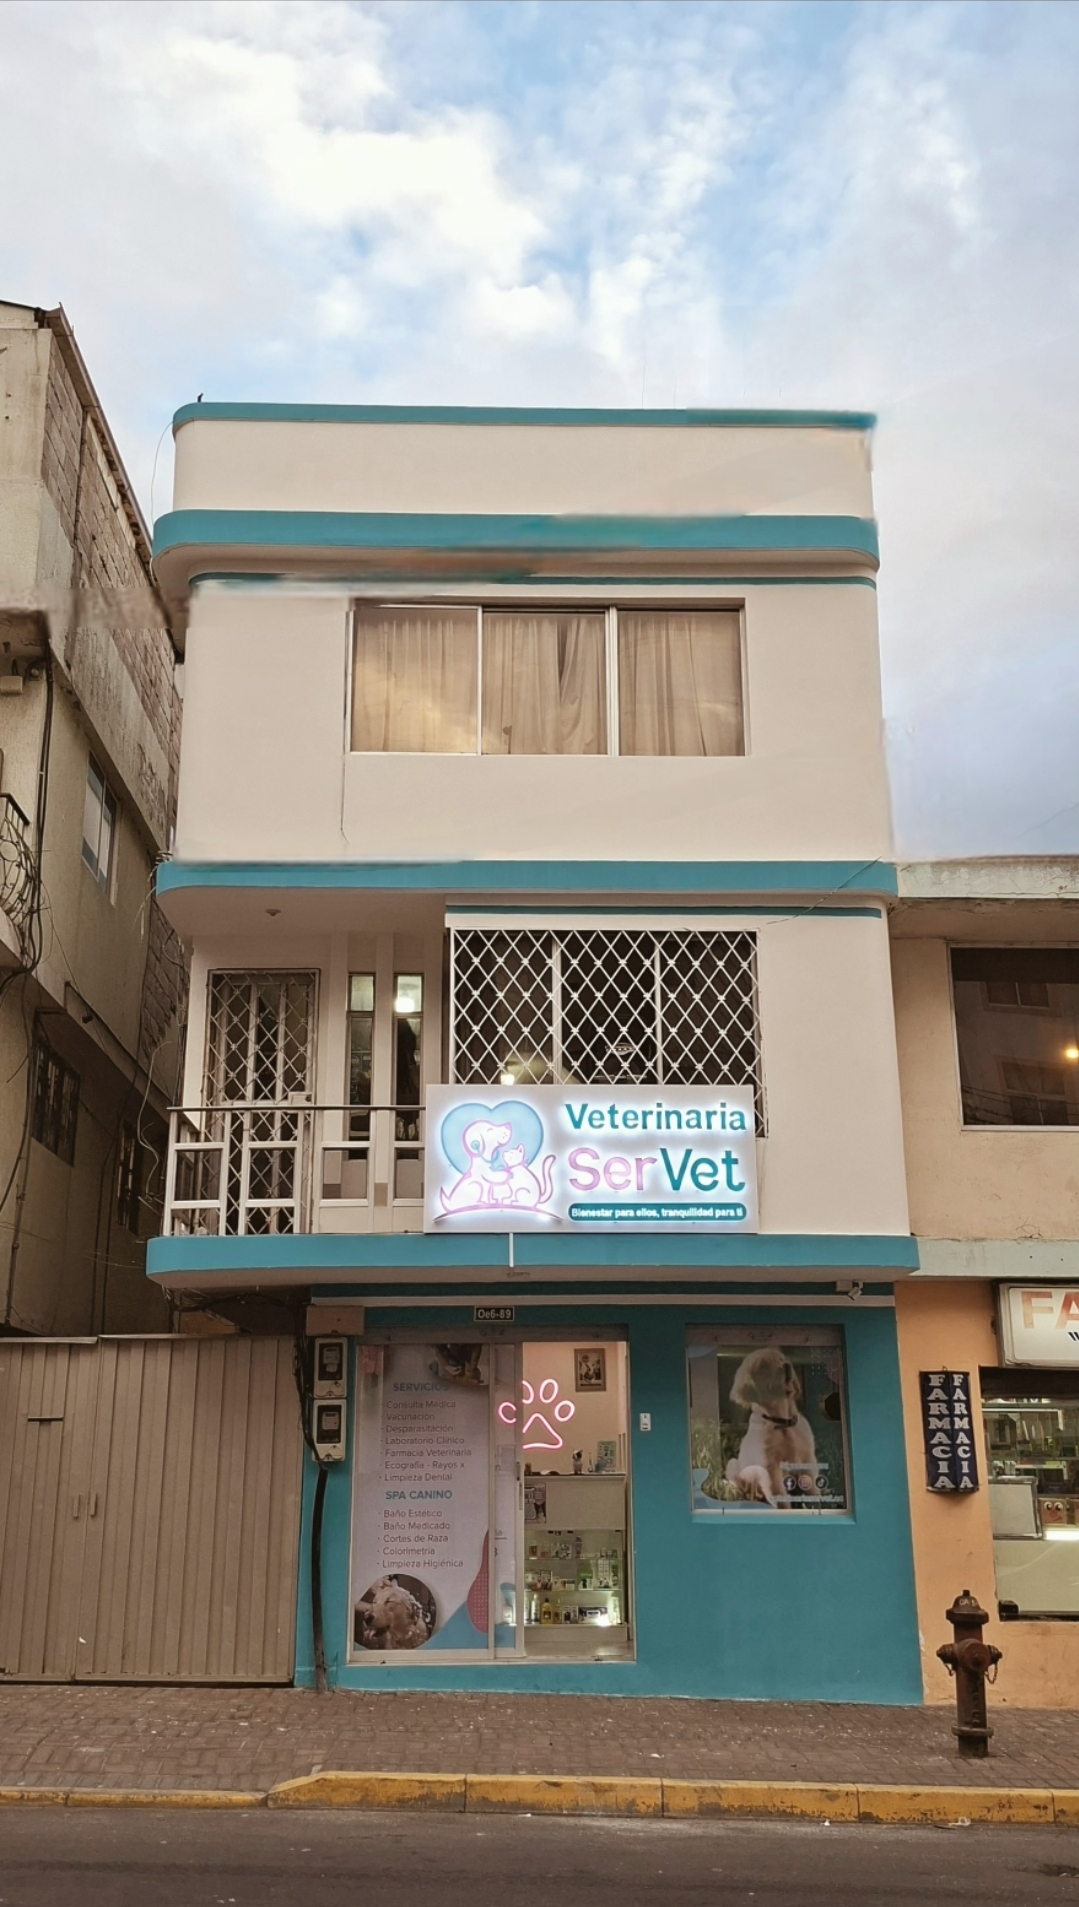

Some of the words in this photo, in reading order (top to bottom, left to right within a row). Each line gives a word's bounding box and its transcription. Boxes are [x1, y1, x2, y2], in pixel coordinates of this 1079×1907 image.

[564, 1102, 747, 1131] Veterinaria
[568, 1147, 746, 1192] SerVet
[571, 1207, 613, 1217] Bienestar
[614, 1208, 635, 1219] para
[635, 1207, 660, 1218] ellos,
[661, 1207, 714, 1219] tranquilidad
[715, 1208, 735, 1219] para
[736, 1206, 743, 1217] ti
[393, 1382, 449, 1392] SERVICIOS
[386, 1400, 423, 1409] Consulta
[926, 1374, 956, 1489] FARMACIA
[952, 1373, 974, 1489] FARMACIA
[385, 1437, 434, 1445] Laboratorio
[385, 1448, 424, 1457] Farmacia
[425, 1448, 472, 1457] Veterinaria
[432, 1460, 458, 1470] Rayos
[384, 1473, 423, 1482] Limpieza
[425, 1472, 453, 1481] Dental
[385, 1490, 406, 1500] SPA
[409, 1489, 453, 1499] CANINO
[383, 1509, 406, 1518] Baño
[383, 1521, 406, 1530] Baño
[408, 1521, 451, 1530] Medicado
[383, 1534, 412, 1543] Cortes
[414, 1534, 426, 1542] de
[427, 1534, 449, 1542] Raza
[382, 1559, 421, 1569] Limpieza
